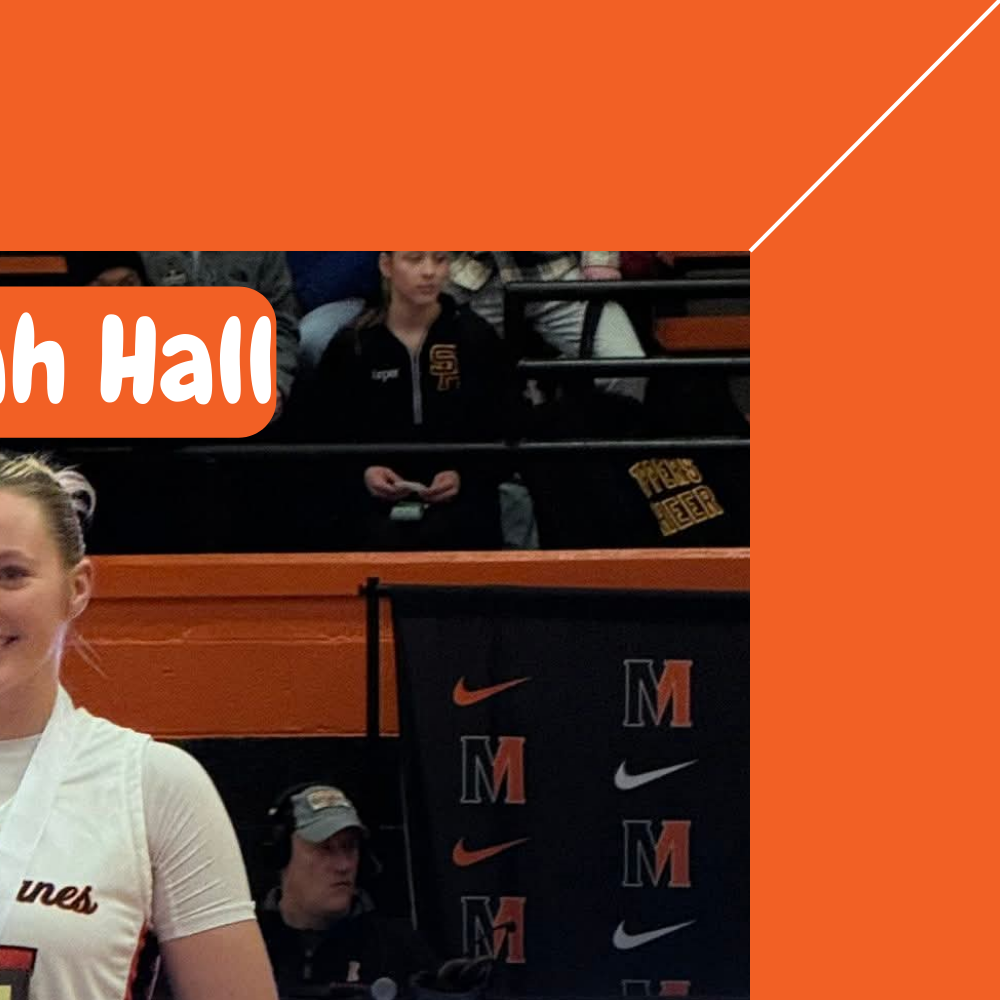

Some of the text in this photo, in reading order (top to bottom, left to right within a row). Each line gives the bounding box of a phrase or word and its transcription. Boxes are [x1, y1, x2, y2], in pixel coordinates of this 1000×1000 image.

[623, 658, 693, 728] M
[460, 735, 526, 805] M
[621, 820, 691, 888] M
[460, 896, 527, 964] M
